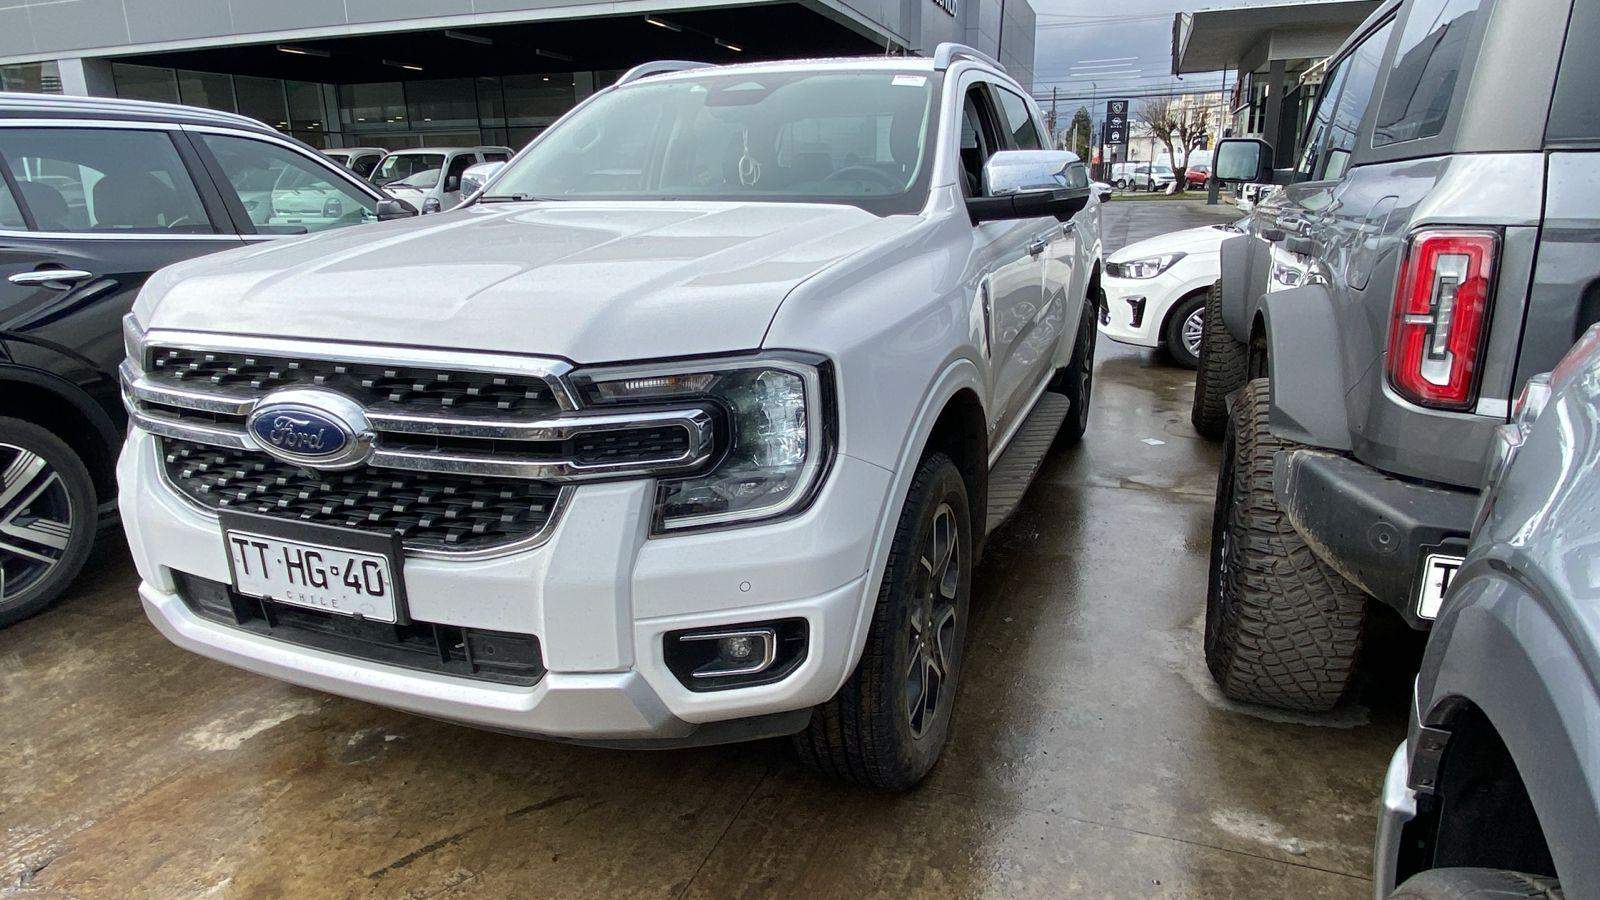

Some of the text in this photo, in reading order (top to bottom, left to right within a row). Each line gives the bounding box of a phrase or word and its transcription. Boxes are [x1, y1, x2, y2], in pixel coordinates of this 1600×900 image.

[270, 416, 325, 449] Ford
[232, 538, 384, 597] TT HG 40
[286, 590, 337, 608] CHILE
